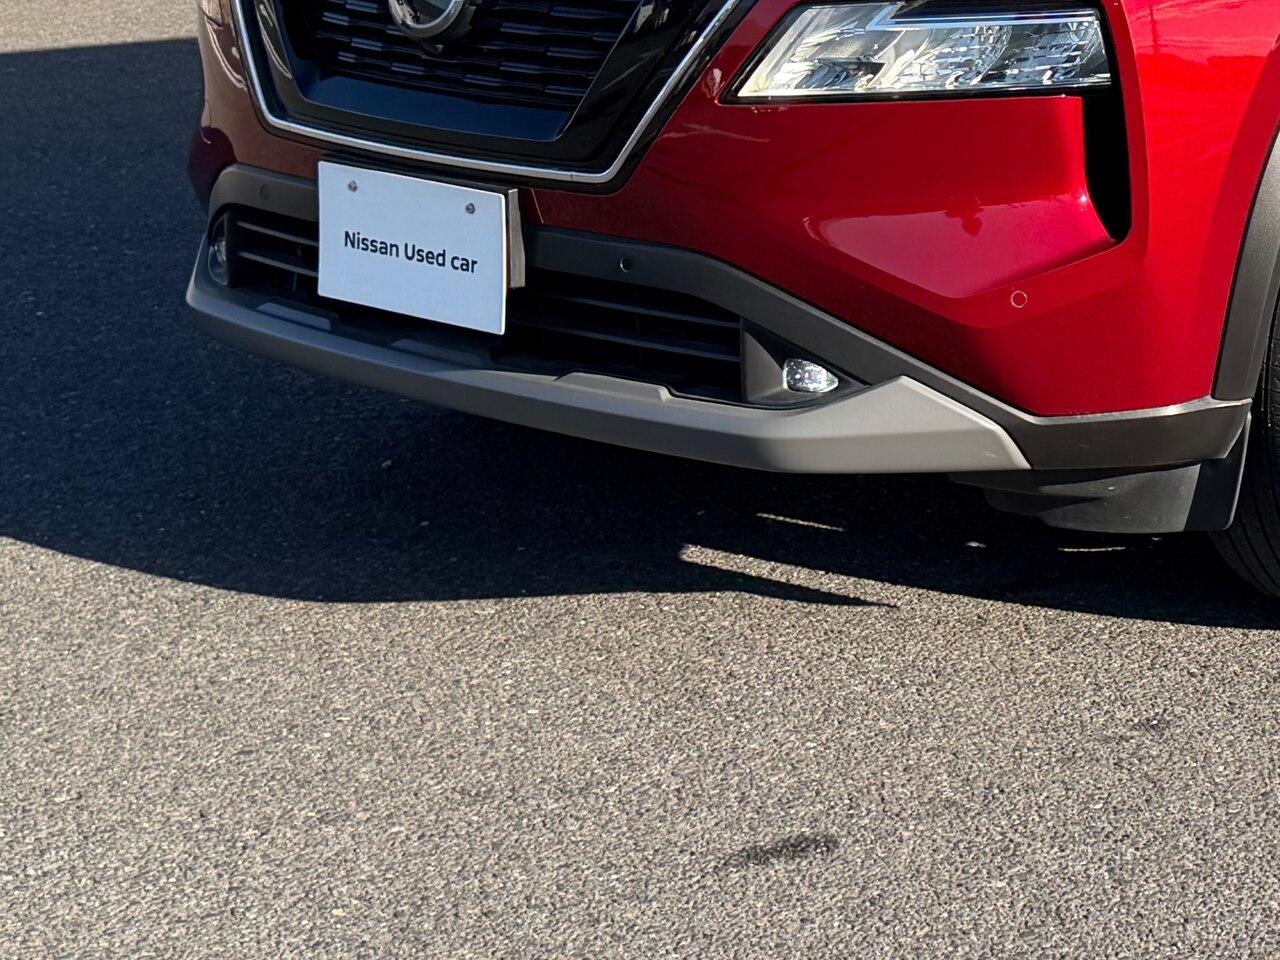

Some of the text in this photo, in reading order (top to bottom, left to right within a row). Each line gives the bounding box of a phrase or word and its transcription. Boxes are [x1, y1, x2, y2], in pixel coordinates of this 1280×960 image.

[344, 230, 478, 273] Nissan Used car
